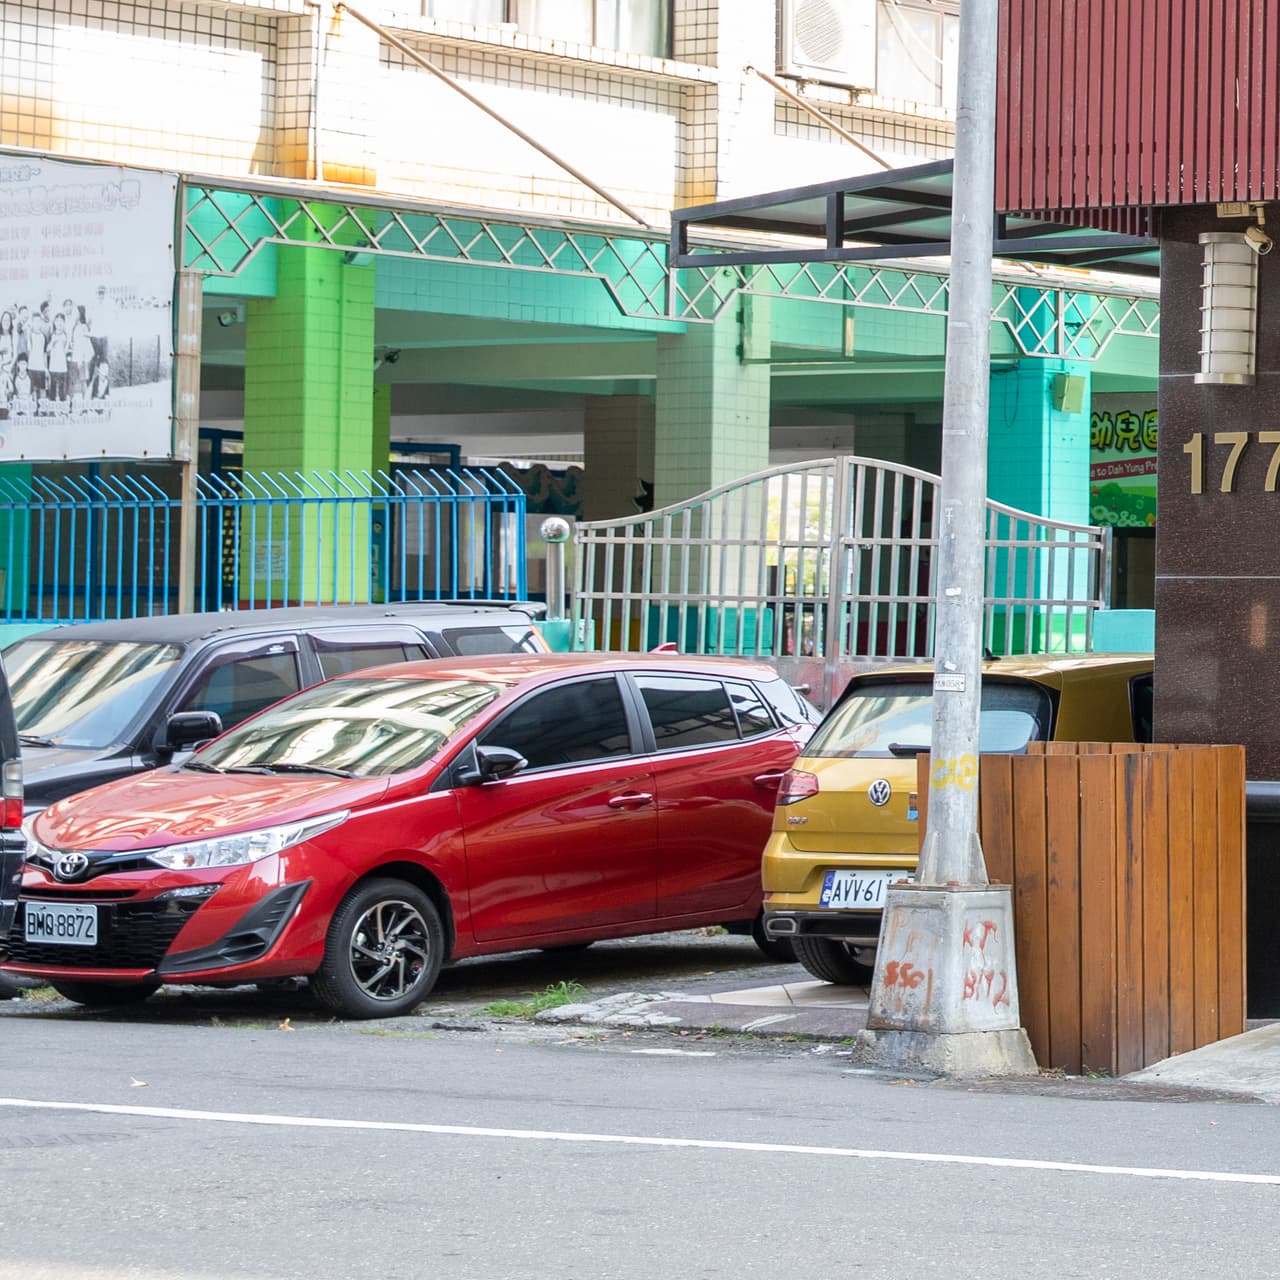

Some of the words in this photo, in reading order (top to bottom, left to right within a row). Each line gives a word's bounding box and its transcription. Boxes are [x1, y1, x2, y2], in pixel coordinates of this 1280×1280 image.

[1125, 463, 1145, 474] Yung
[832, 878, 893, 903] AVV-61
[27, 912, 95, 939] BMQ-8872
